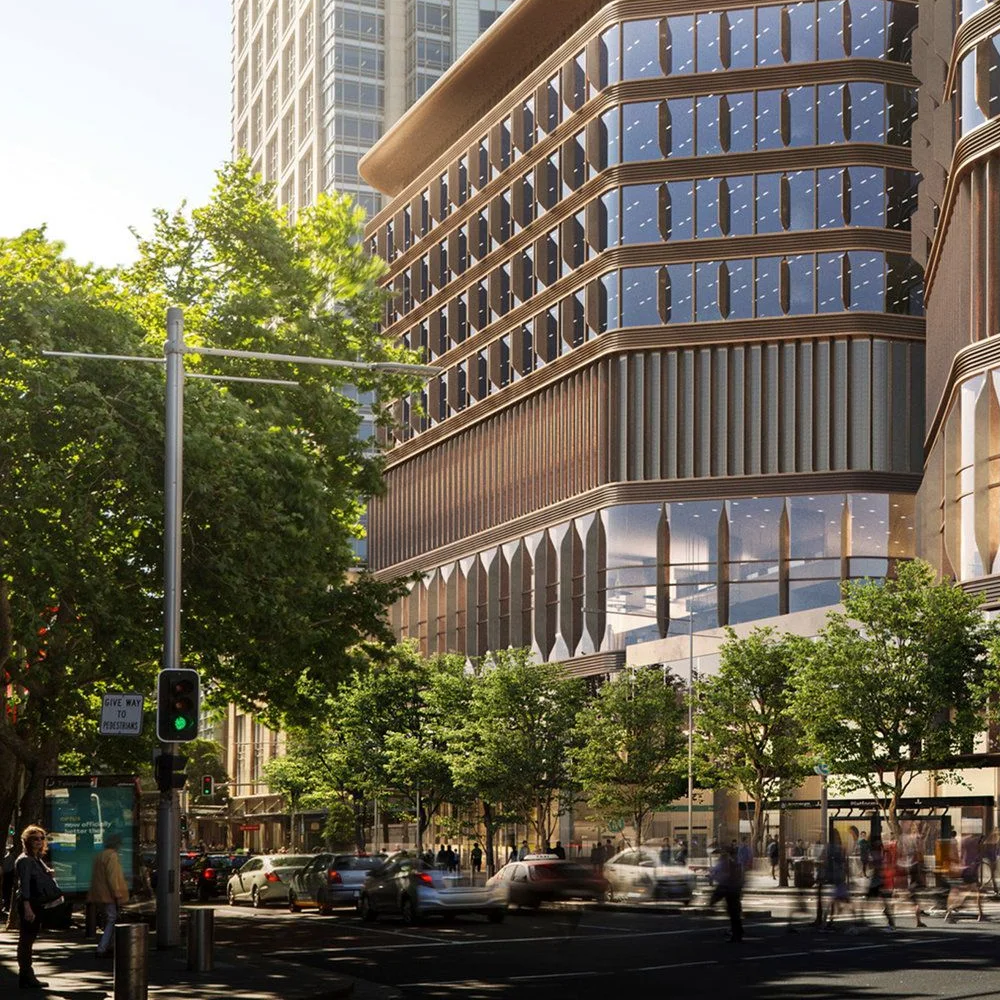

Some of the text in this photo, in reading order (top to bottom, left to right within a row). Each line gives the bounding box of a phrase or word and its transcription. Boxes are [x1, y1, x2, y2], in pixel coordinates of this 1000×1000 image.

[105, 699, 141, 707] GIVE WAY
[117, 710, 126, 718] TO
[103, 721, 137, 730] PEDESTRIANS
